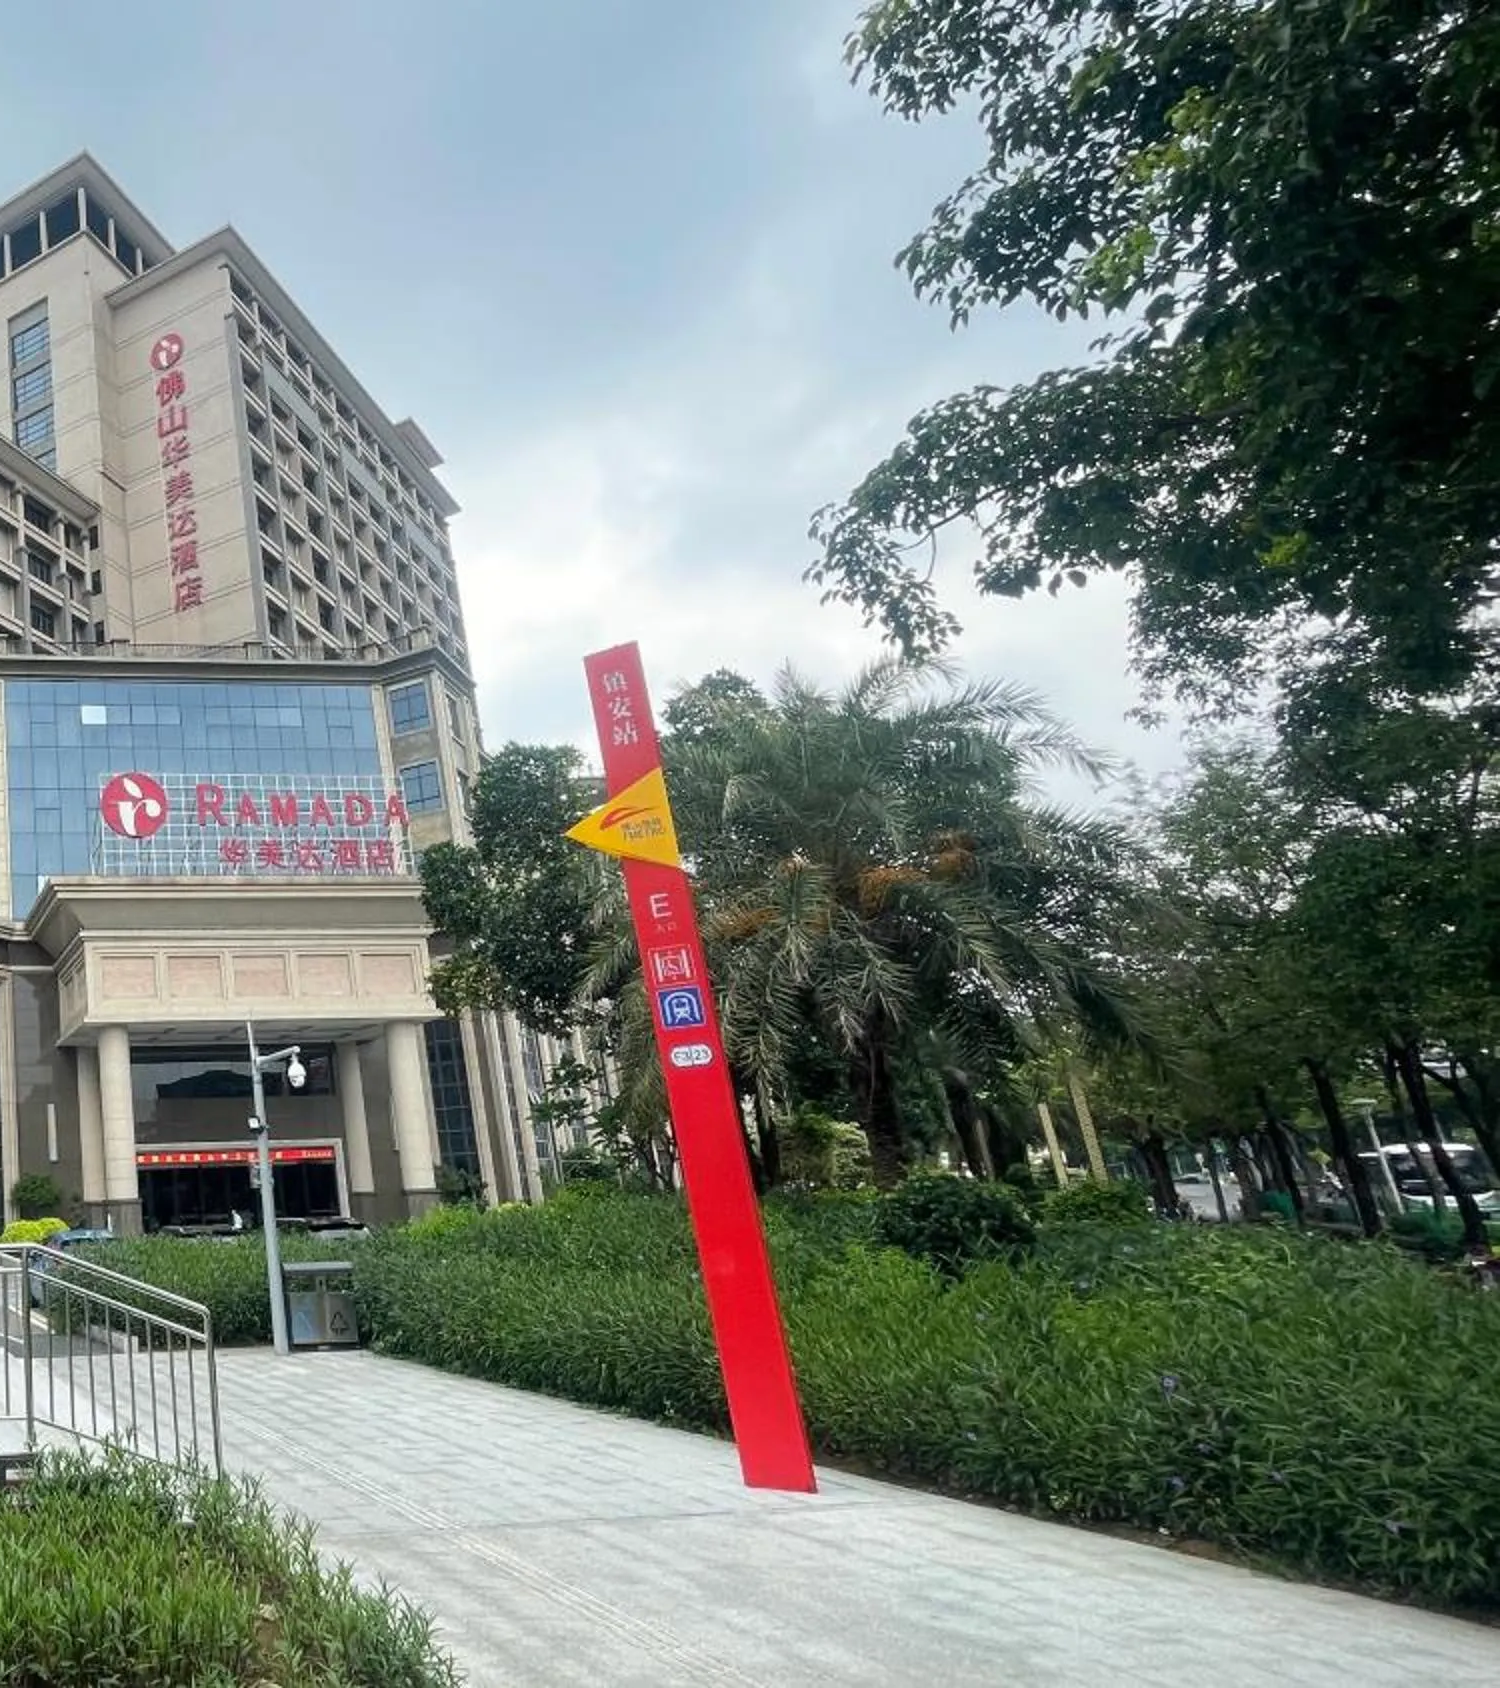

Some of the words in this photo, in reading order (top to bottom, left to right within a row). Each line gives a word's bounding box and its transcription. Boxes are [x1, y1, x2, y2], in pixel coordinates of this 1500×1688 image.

[156, 370, 204, 613] 佛山华美达酒店
[196, 784, 410, 827] RAMADA
[219, 839, 398, 872] 华美达酒店
[649, 892, 674, 919] E
